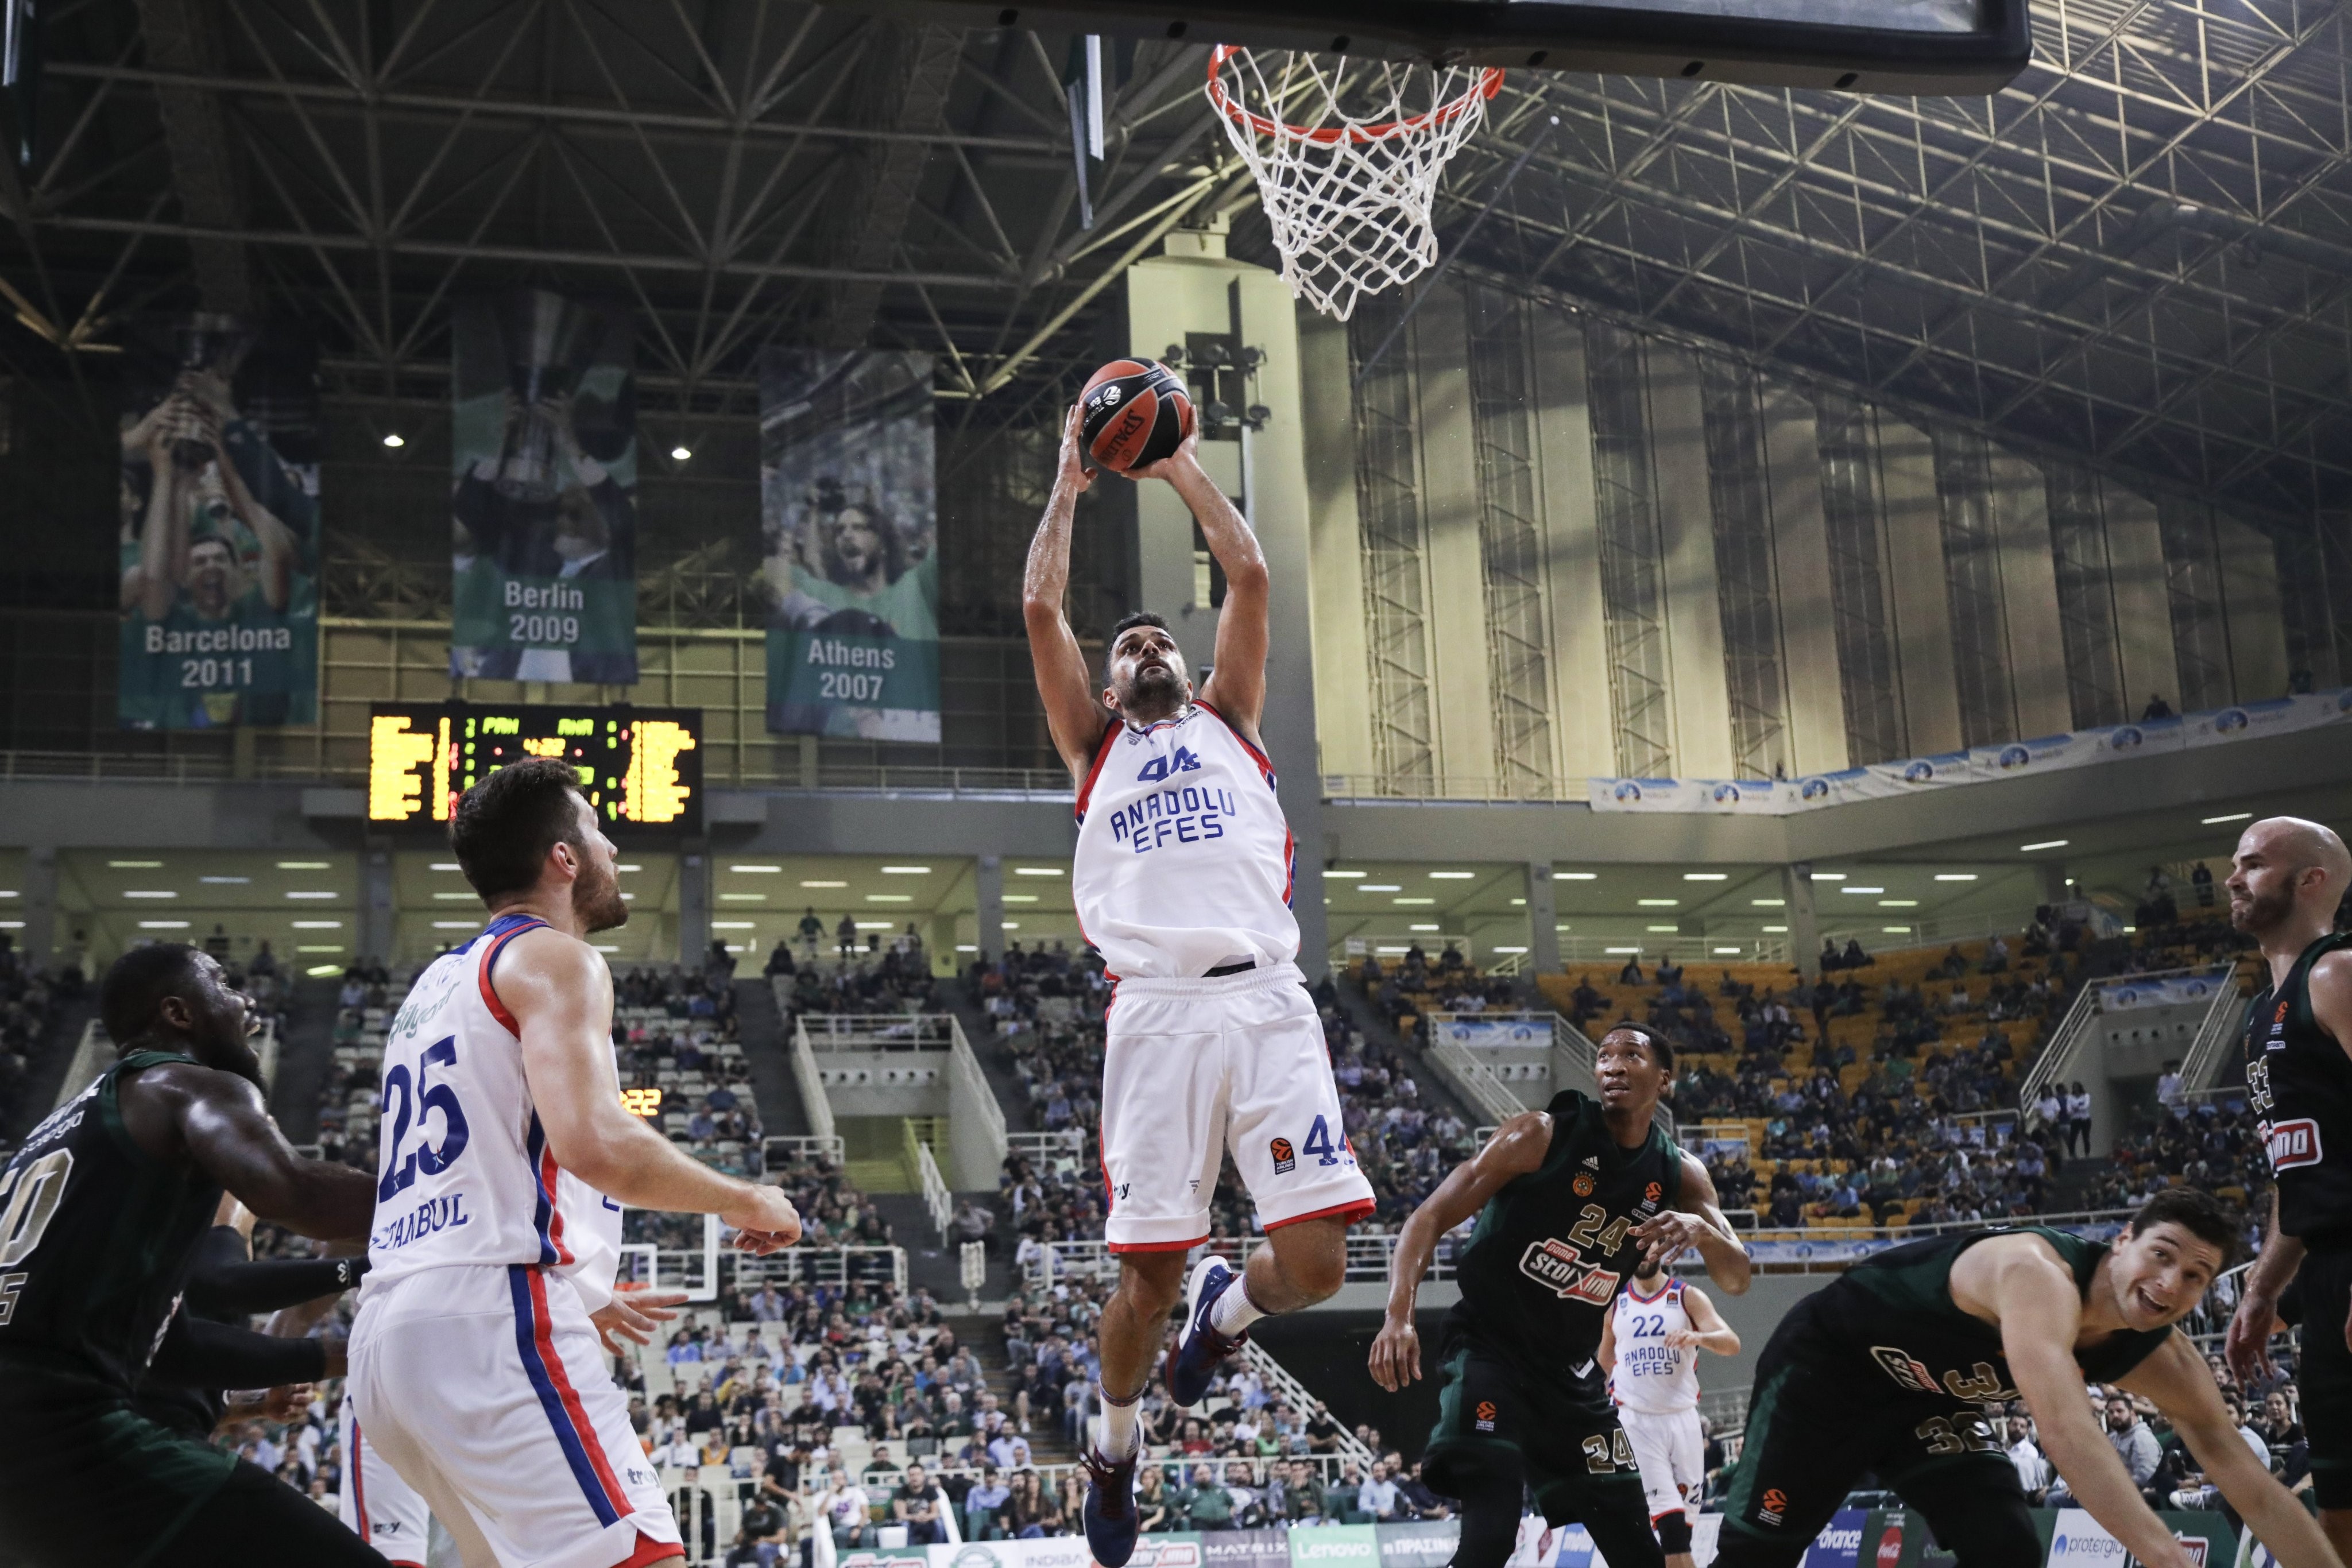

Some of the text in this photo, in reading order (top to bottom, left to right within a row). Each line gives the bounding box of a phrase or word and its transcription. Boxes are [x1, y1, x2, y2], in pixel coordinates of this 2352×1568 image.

[1098, 409, 1146, 461] SPALDI
[505, 581, 584, 610] Berlin
[145, 625, 291, 653] Barcelona
[510, 614, 579, 643] 2009
[807, 638, 896, 669] Athens
[181, 659, 253, 688] 2011
[819, 671, 884, 702] 2007
[1110, 787, 1236, 843] ANADOLU
[1133, 814, 1224, 854] EFES
[378, 1035, 470, 1204] 25
[0, 1147, 74, 1268] 0
[1568, 1203, 1632, 1257] 24
[1546, 1243, 1574, 1260] pame
[1632, 1314, 1666, 1338] 22
[1624, 1346, 1681, 1366] ANADOLU
[1633, 1361, 1674, 1376] EFES
[1582, 1428, 1638, 1474] 24
[1206, 1542, 1287, 1555] MATRIX
[1297, 1542, 1372, 1559] Lenovo
[2068, 1536, 2123, 1558] protergia
